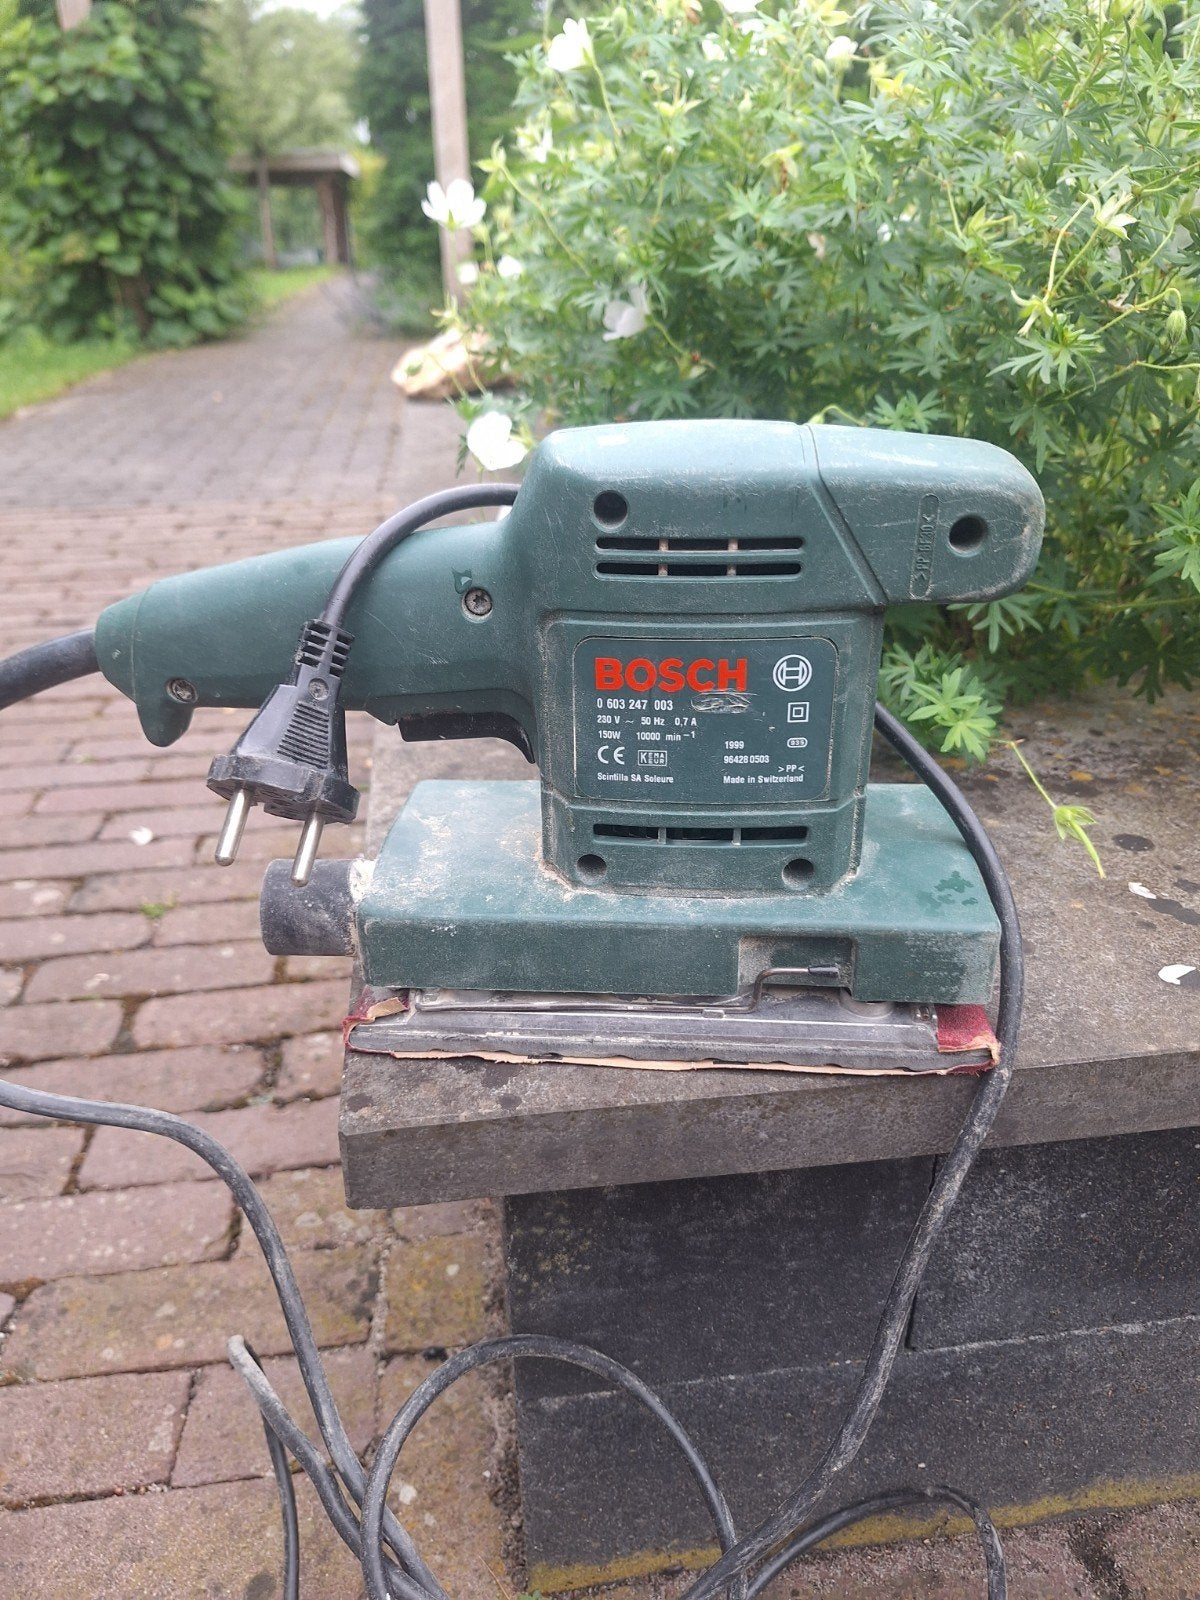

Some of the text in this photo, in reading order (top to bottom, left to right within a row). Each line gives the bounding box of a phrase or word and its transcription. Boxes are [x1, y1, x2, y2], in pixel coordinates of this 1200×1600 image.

[595, 657, 748, 692] BOSCH
[596, 698, 674, 711] 0 603 247 003
[597, 715, 612, 724] 230
[614, 715, 621, 724] V
[641, 717, 652, 726] 50
[653, 717, 666, 726] Hz
[674, 717, 689, 727] 0,7
[690, 717, 698, 726] A
[598, 730, 621, 740] 150W
[636, 732, 661, 741] 10000
[724, 741, 745, 750] 1999
[597, 745, 626, 765] CE
[597, 772, 629, 782] Scintilla
[630, 774, 642, 783] SA
[723, 774, 804, 784] Made in Switzerland
